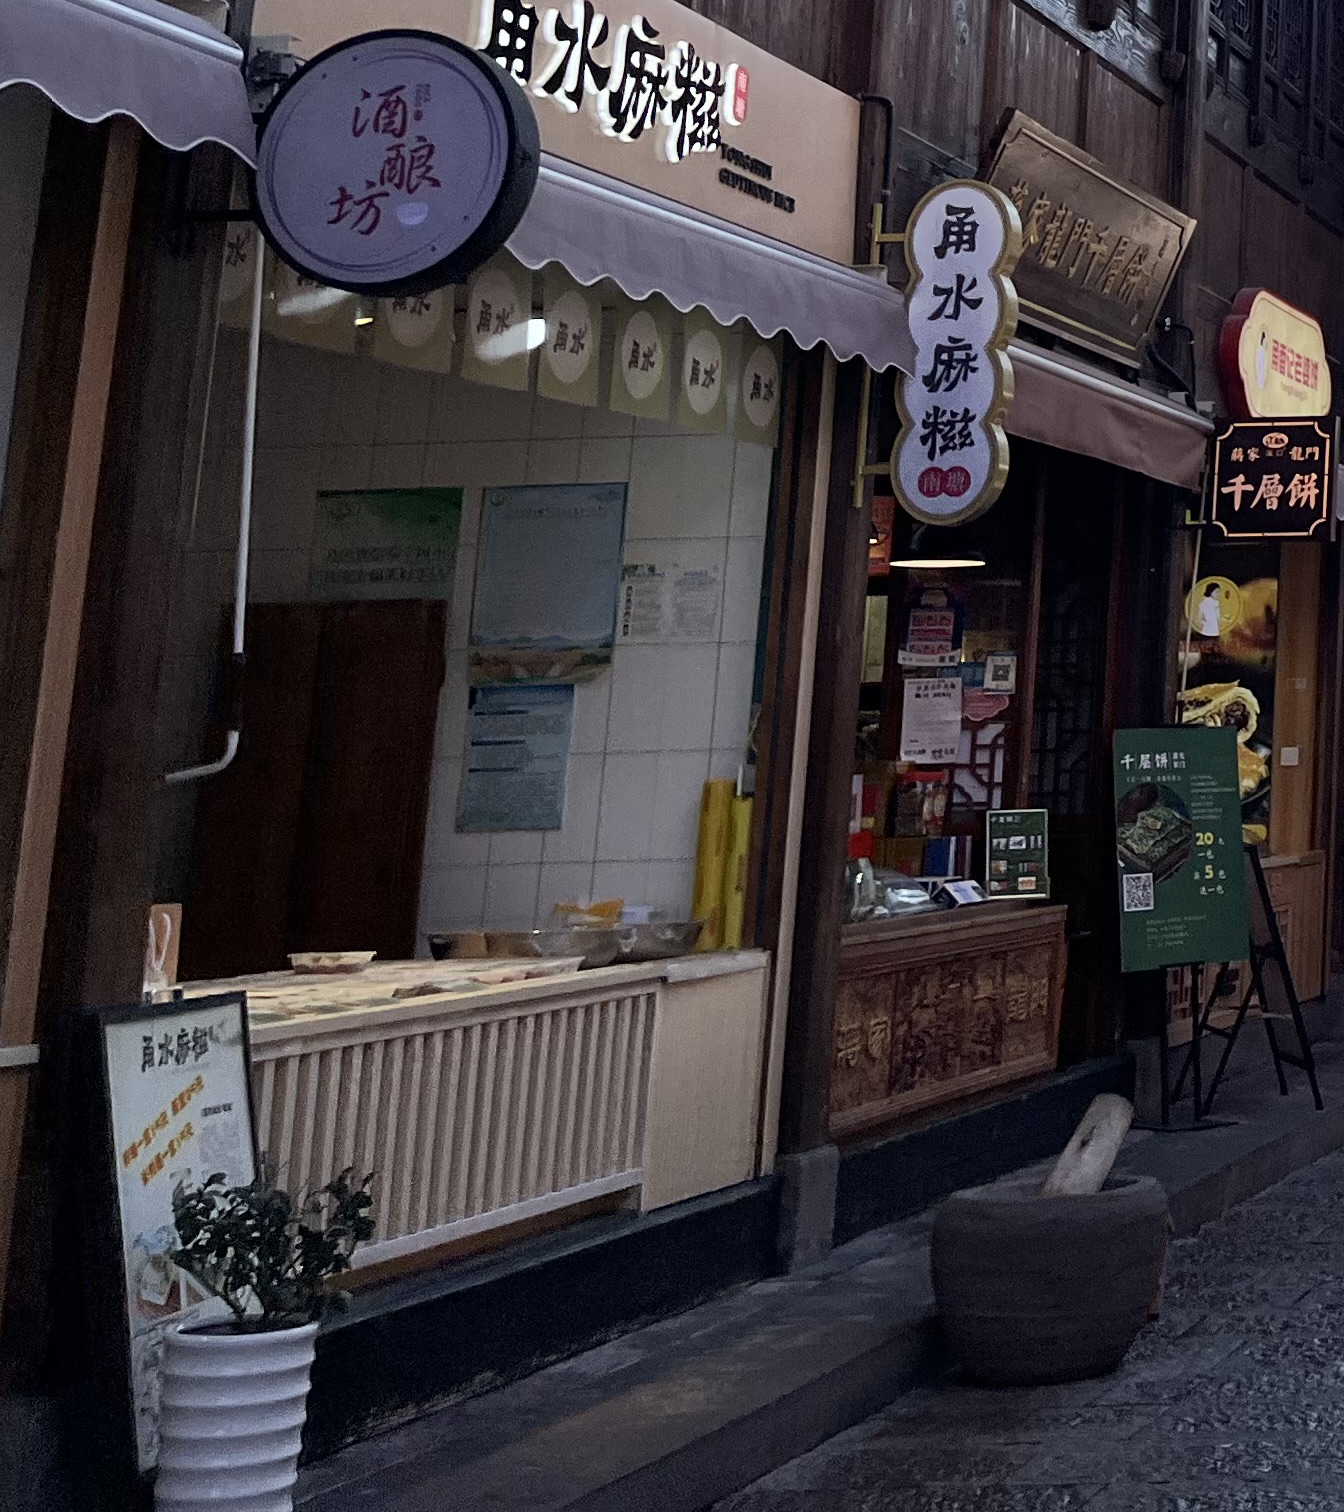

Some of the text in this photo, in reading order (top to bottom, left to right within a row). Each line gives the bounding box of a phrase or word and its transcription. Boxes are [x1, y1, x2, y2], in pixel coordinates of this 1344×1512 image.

[920, 204, 984, 461] 甬水麻糍
[1220, 473, 1320, 511] 千層餅
